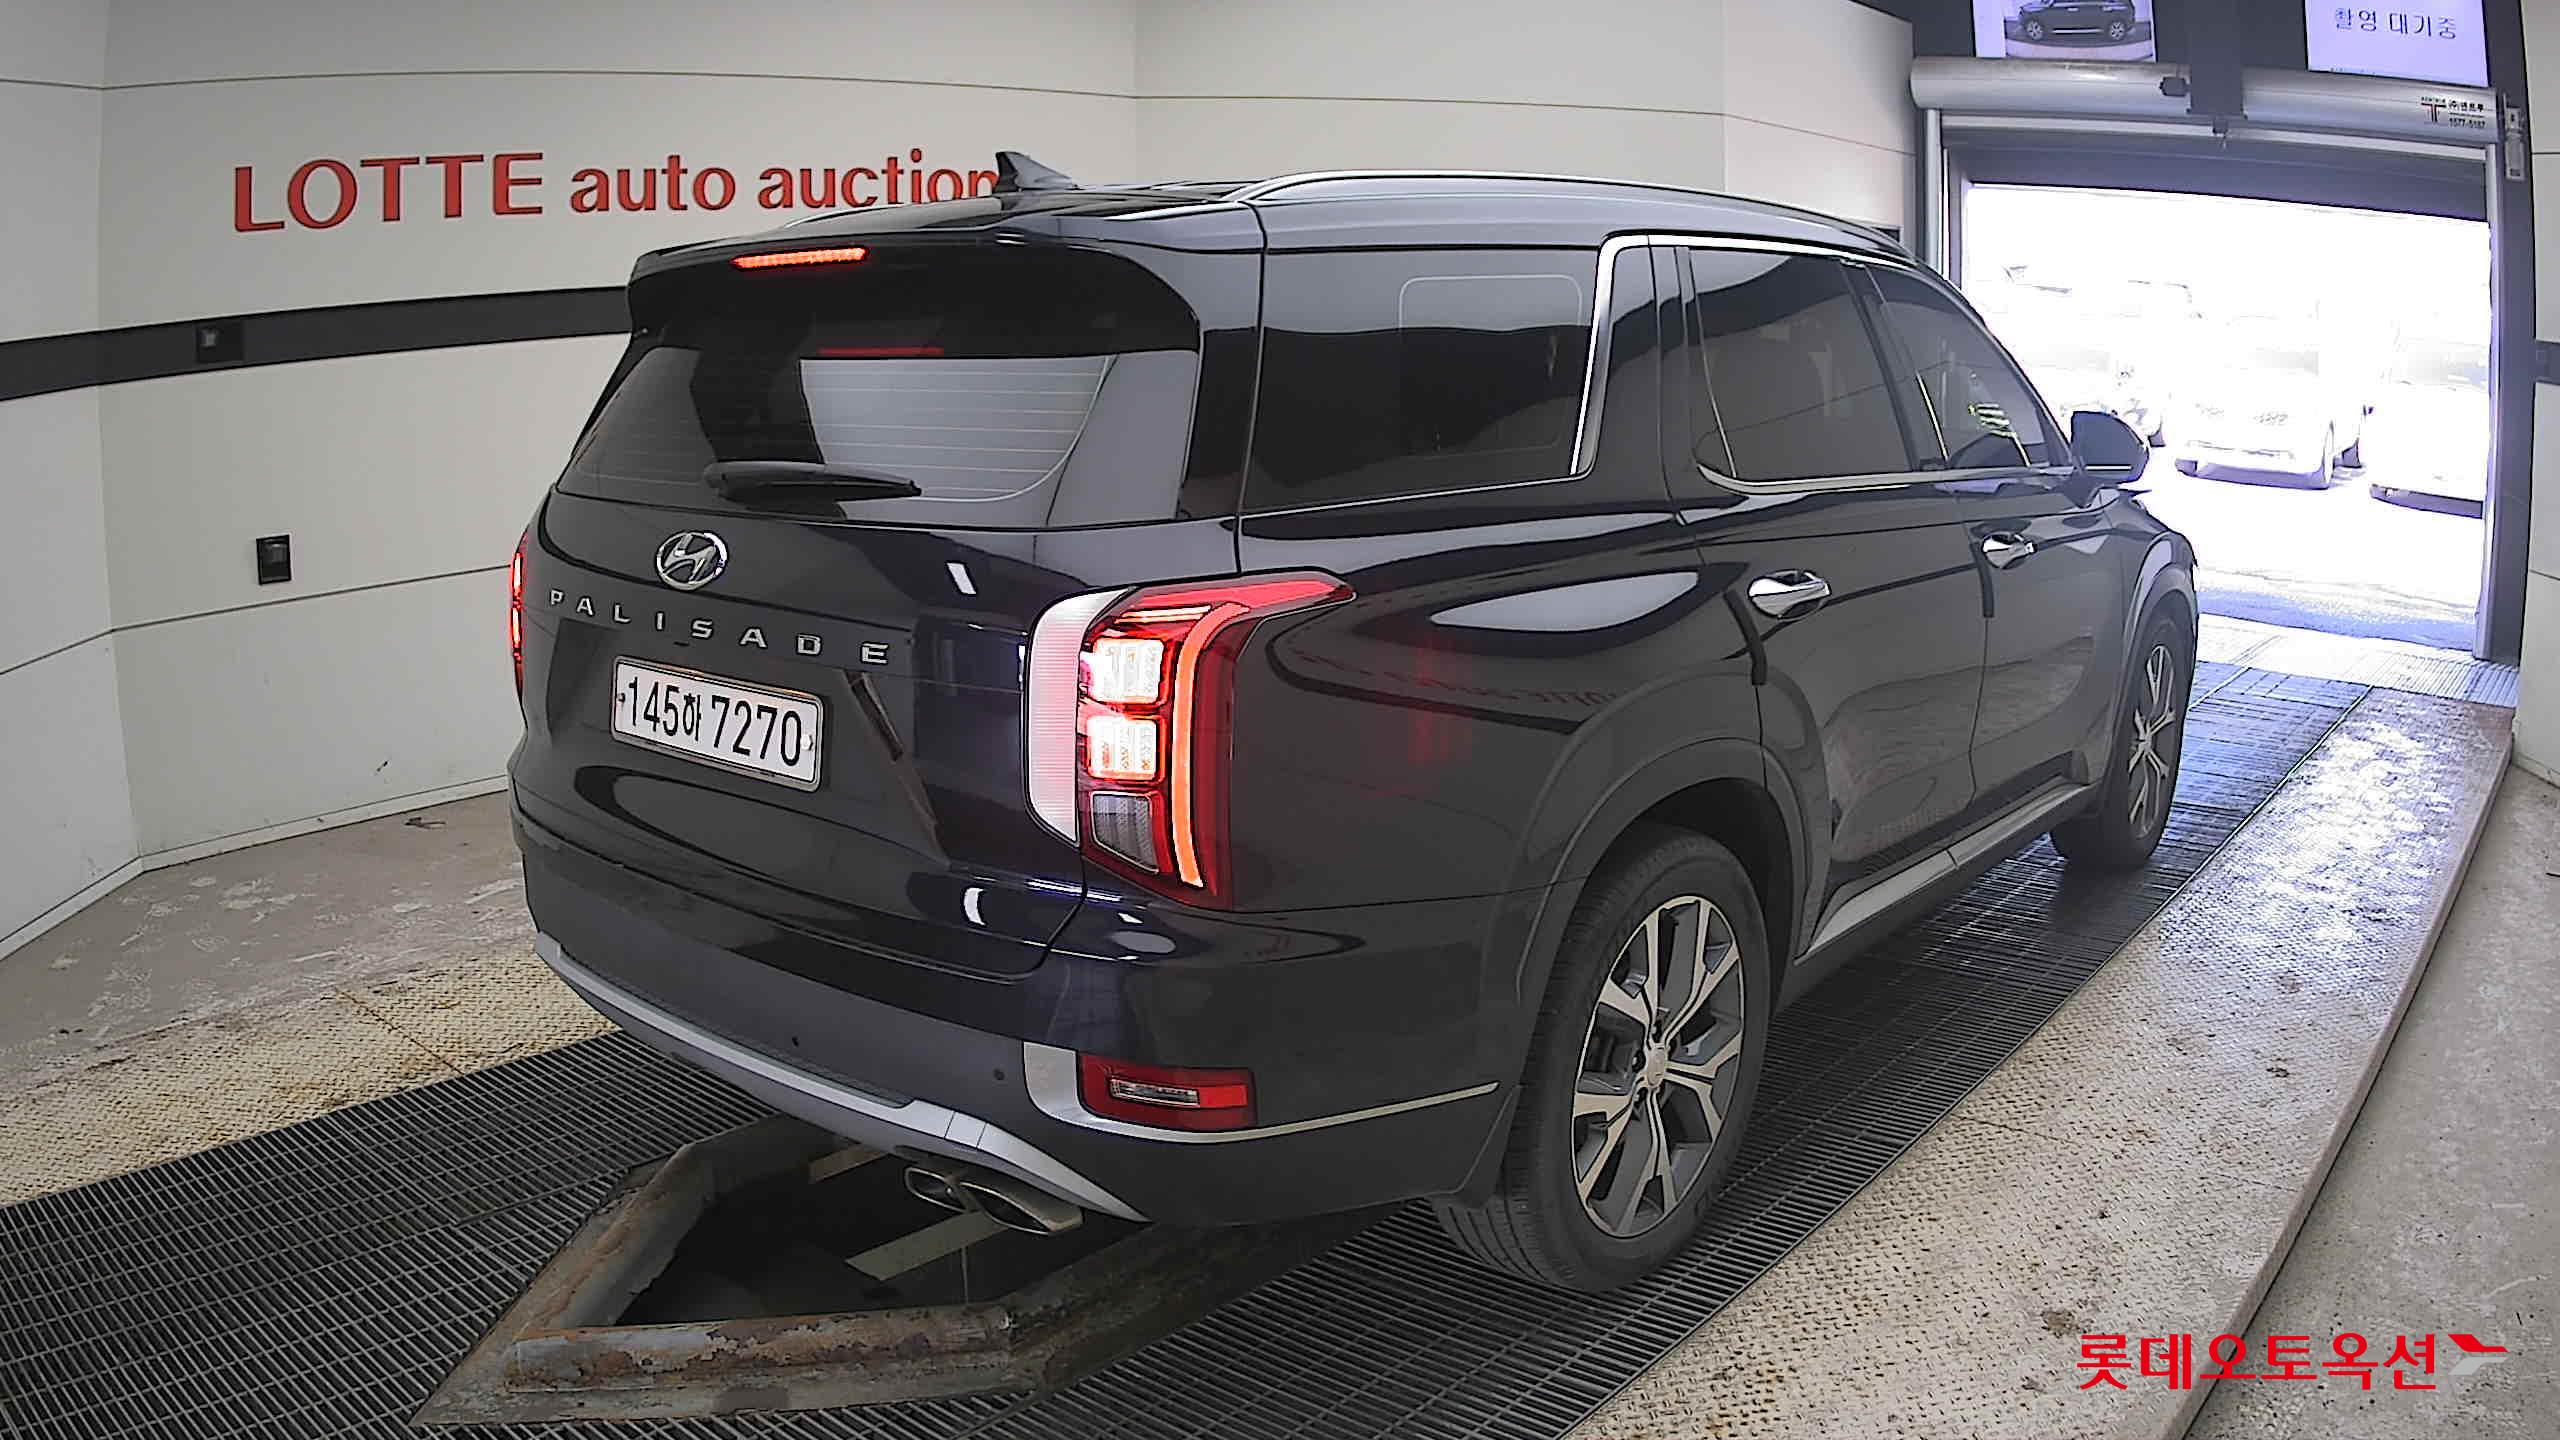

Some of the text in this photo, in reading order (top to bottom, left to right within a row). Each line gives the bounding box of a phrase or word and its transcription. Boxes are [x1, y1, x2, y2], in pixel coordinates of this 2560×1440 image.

[233, 148, 998, 232] LOTTE auto auction
[549, 588, 890, 666] PALISADE
[711, 694, 801, 767] 7270
